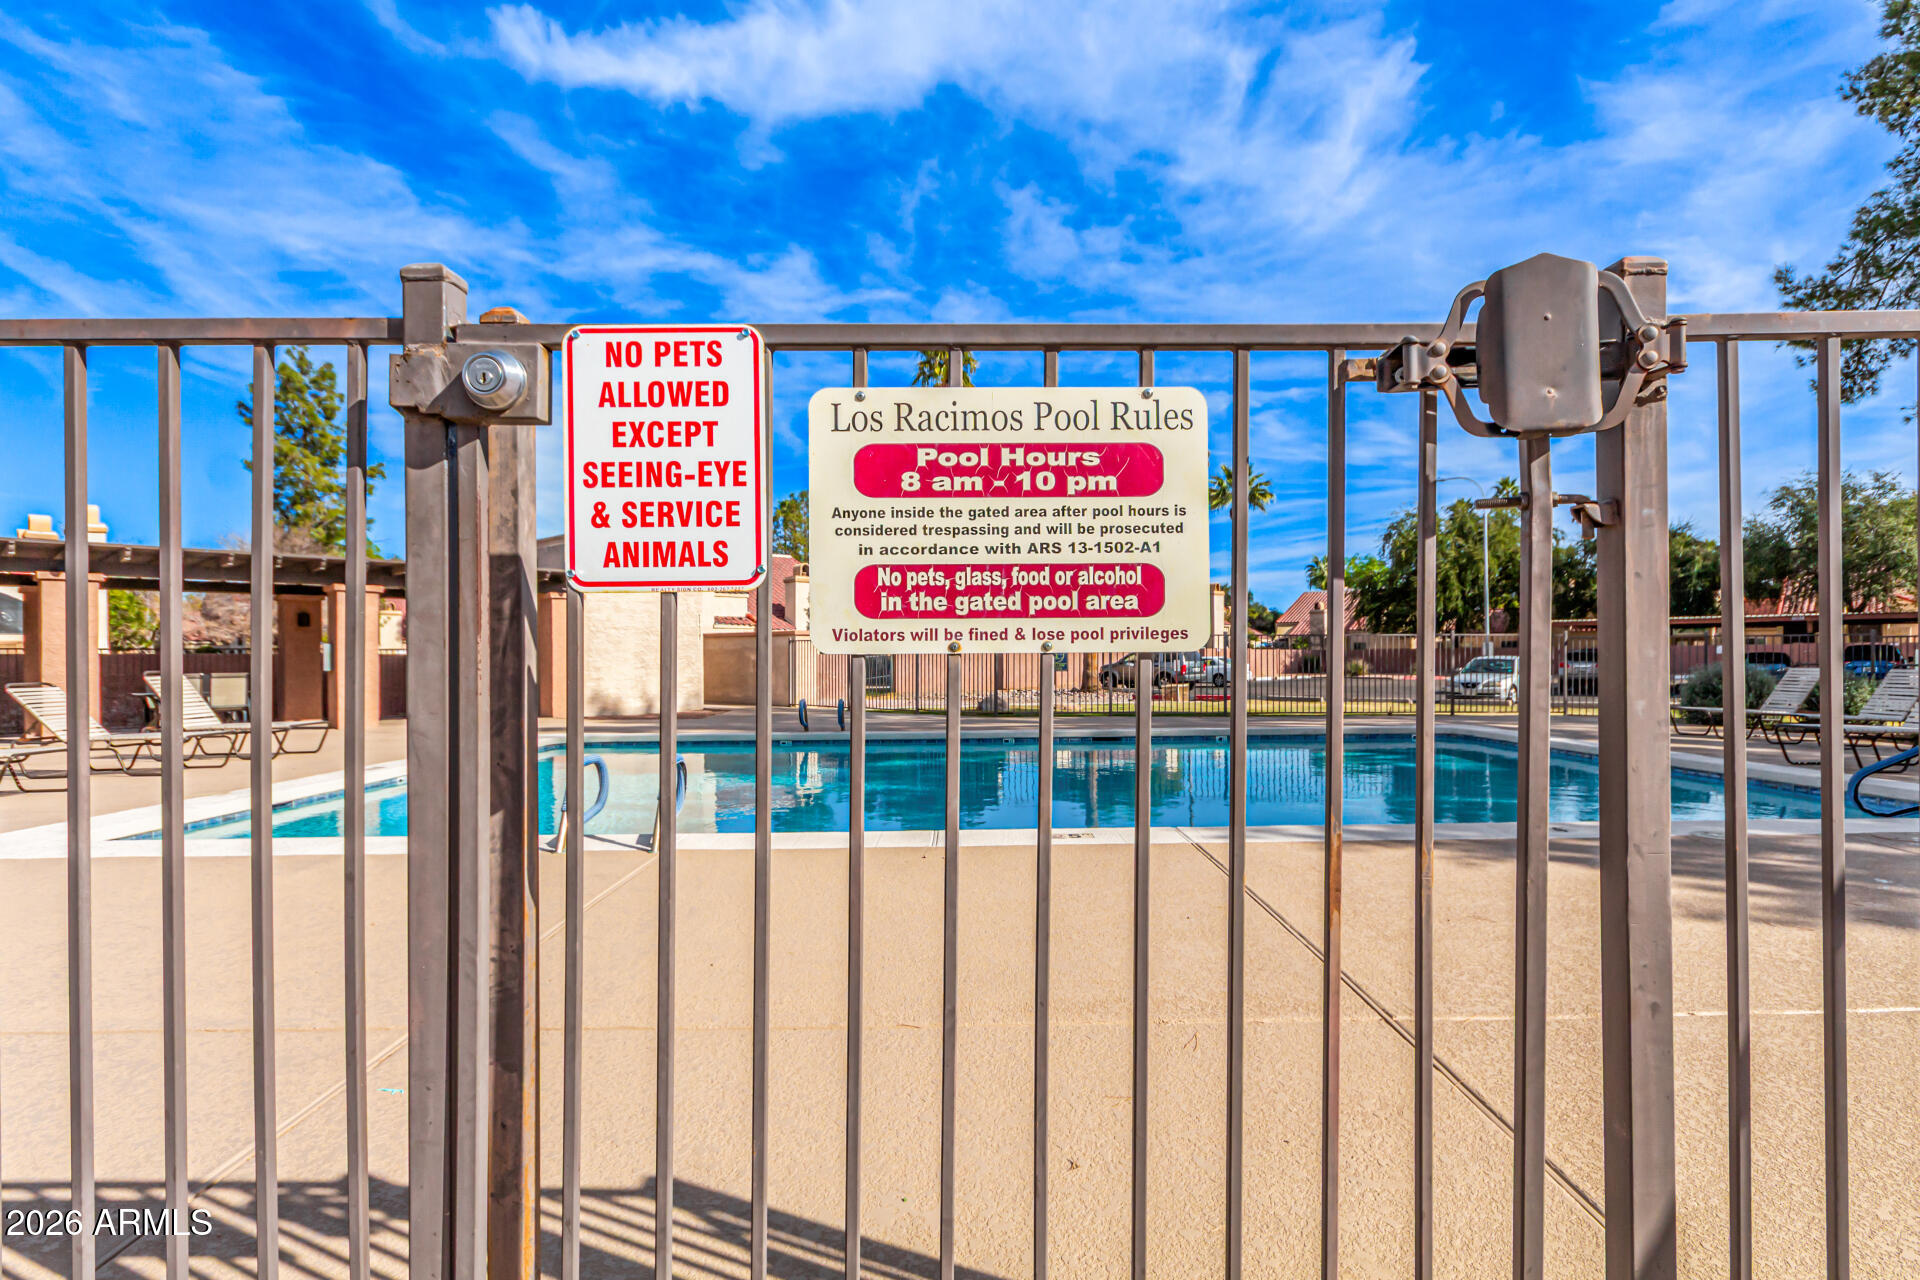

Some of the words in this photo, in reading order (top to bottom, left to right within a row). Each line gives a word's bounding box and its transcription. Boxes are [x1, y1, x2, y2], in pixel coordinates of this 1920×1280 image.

[605, 340, 643, 368] NO
[654, 340, 723, 368] PETS
[598, 380, 730, 409] ALLOWED
[830, 402, 883, 432] Los
[893, 400, 1023, 432] Racimos
[1033, 400, 1100, 432] Pool
[1110, 399, 1194, 431] Rules
[611, 421, 719, 449] EXCEPT
[916, 447, 989, 468] Pool
[1000, 447, 1101, 468] Hours
[582, 460, 748, 489] SEEING-EYE
[900, 471, 921, 492] 8
[931, 475, 983, 491] am
[1016, 471, 1056, 491] 10
[1067, 474, 1118, 495] pm
[590, 500, 611, 529] &
[621, 500, 741, 529] SERVICE
[831, 507, 886, 521] Anyone
[890, 506, 935, 519] inside
[939, 506, 963, 518] the
[968, 506, 1010, 521] gated
[1014, 508, 1047, 518] area
[1052, 505, 1088, 518] after
[1092, 505, 1123, 519] pool
[1128, 504, 1170, 517] hours
[1174, 504, 1187, 517] is
[834, 524, 917, 537] considered
[922, 524, 1009, 539] trespassing
[1014, 523, 1041, 536] and
[1045, 523, 1073, 535] will
[1077, 522, 1095, 535] be
[1100, 522, 1184, 538] prosecuted
[602, 540, 729, 569] ANIMALS
[858, 543, 874, 556] in
[879, 543, 980, 556] accordance
[984, 542, 1022, 555] with
[1026, 542, 1062, 555] ARS
[1067, 540, 1161, 555] 13-1502-A1
[877, 567, 901, 587] No
[906, 568, 950, 590] pets,
[954, 567, 1007, 590] glass,
[1011, 566, 1051, 587] food
[1054, 571, 1074, 586] or
[1078, 566, 1142, 586] alcohol
[880, 592, 902, 612] in
[908, 592, 948, 612] the
[954, 591, 1022, 616] gated
[1028, 590, 1079, 615] pool
[1085, 594, 1139, 611] area
[831, 628, 906, 642] Violators
[909, 628, 939, 642] will
[944, 628, 963, 642] be
[968, 627, 1009, 641] fined
[1014, 627, 1026, 641] &
[1032, 627, 1065, 641] lose
[1070, 627, 1104, 644] pool
[1109, 626, 1189, 644] privileges
